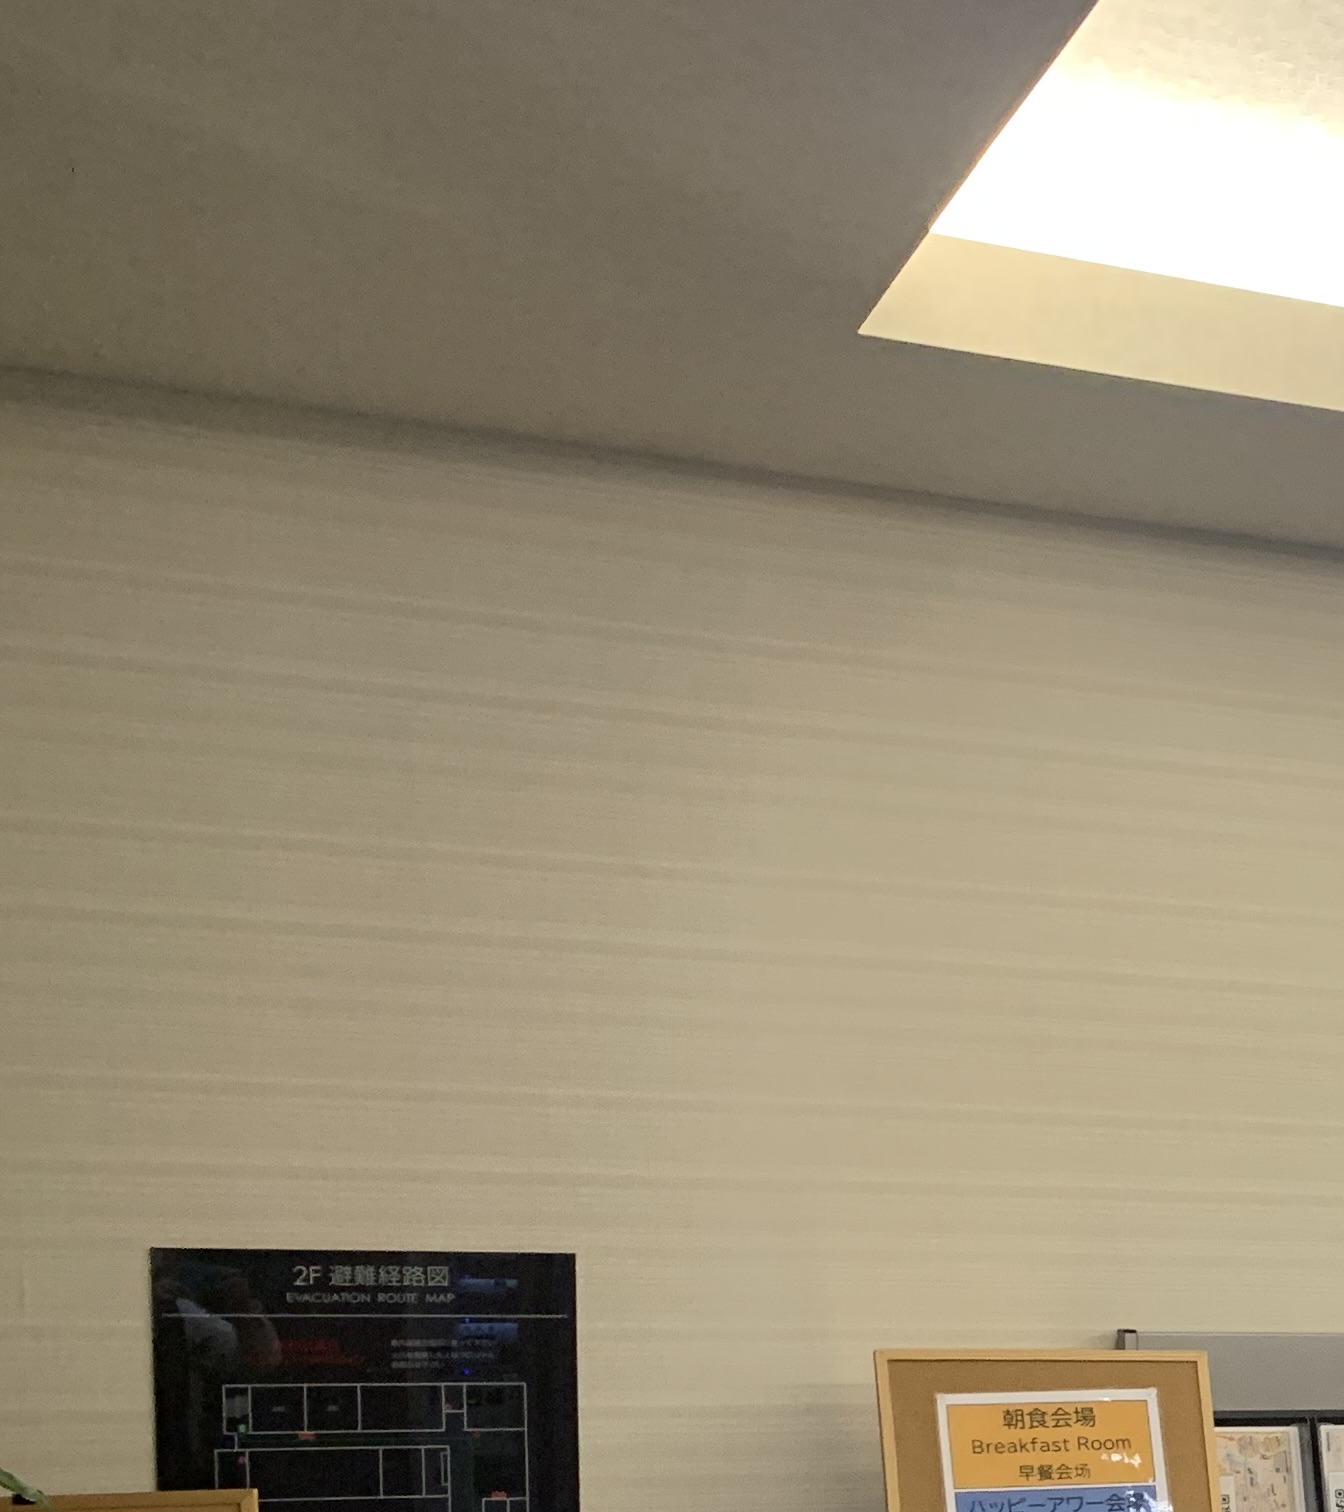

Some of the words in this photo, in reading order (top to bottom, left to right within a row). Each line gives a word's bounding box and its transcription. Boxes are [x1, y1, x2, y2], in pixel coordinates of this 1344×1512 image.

[292, 1266, 322, 1287] 2F
[329, 1265, 449, 1287] 避難経路図
[286, 1292, 371, 1303] EVACUATION
[377, 1292, 418, 1303] ROUTE
[425, 1293, 455, 1303] MAP
[1002, 1407, 1096, 1430] 朝食会場
[972, 1437, 1070, 1455] Breakfast
[1077, 1436, 1132, 1452] Room
[1018, 1463, 1091, 1481] 早餐会场
